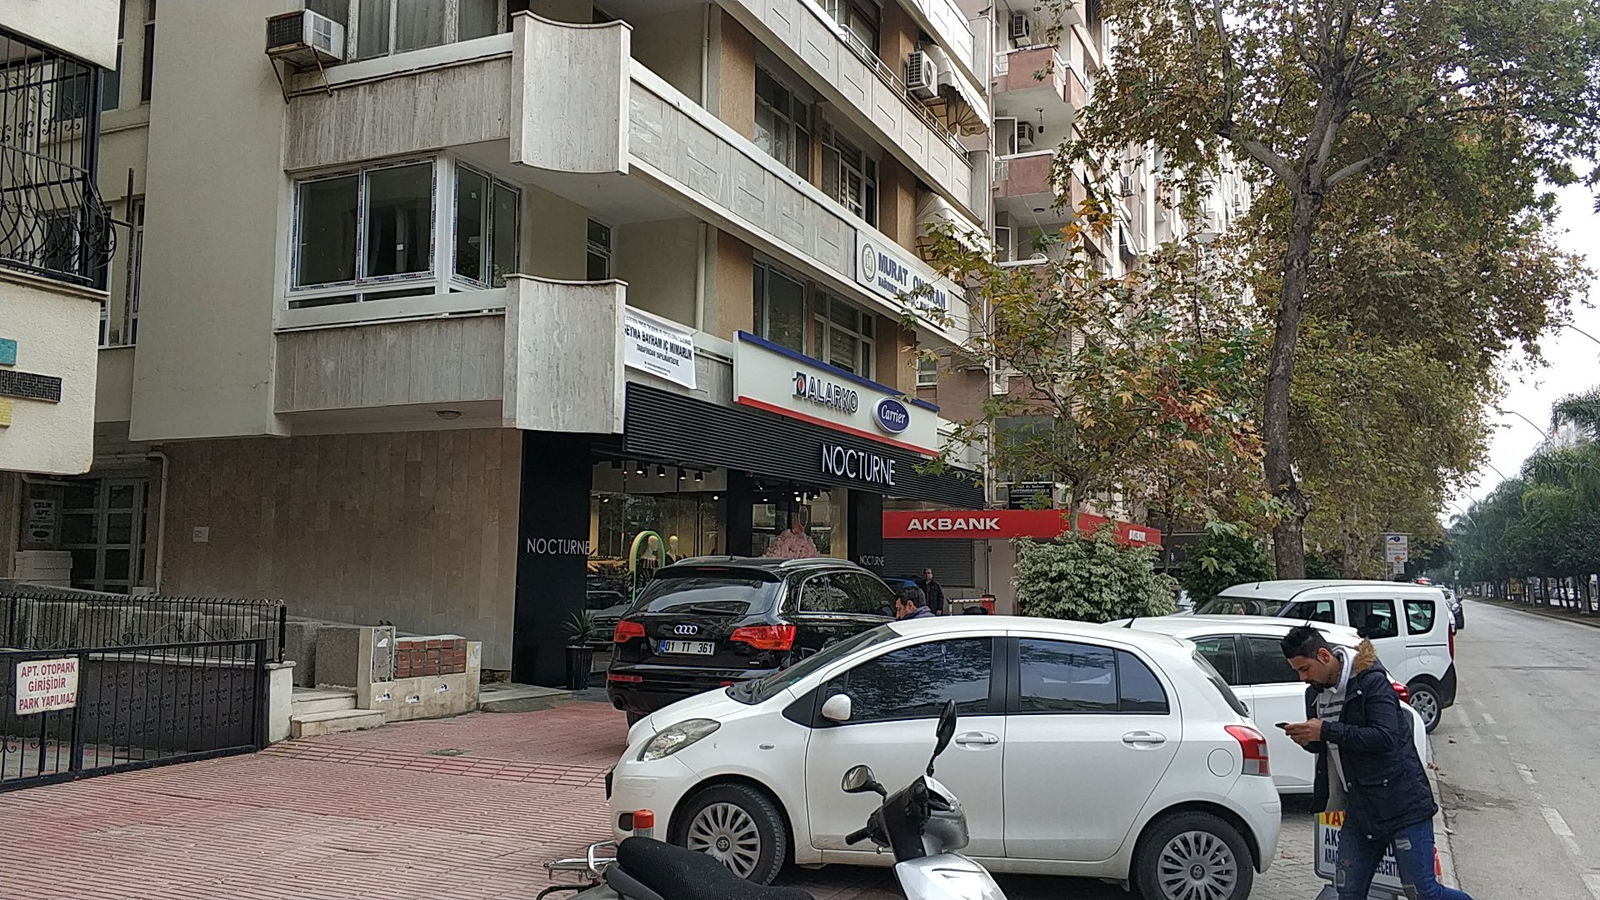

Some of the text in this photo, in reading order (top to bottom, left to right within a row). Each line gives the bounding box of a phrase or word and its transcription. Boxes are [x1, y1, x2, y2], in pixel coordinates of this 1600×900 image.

[878, 252, 908, 287] MURAT
[913, 275, 946, 309] ONRAN
[642, 331, 662, 349] BAYRAM
[808, 376, 859, 414] ALARKO
[881, 404, 906, 424] Carrier
[822, 443, 896, 486] NOCTURNE
[907, 517, 1001, 531] AKBANK
[527, 538, 590, 555] NOCTURNE
[665, 641, 713, 654] 01 TT 361
[21, 661, 76, 678] APT. OTOPARK
[19, 692, 75, 710] PARK YAPILMAZ
